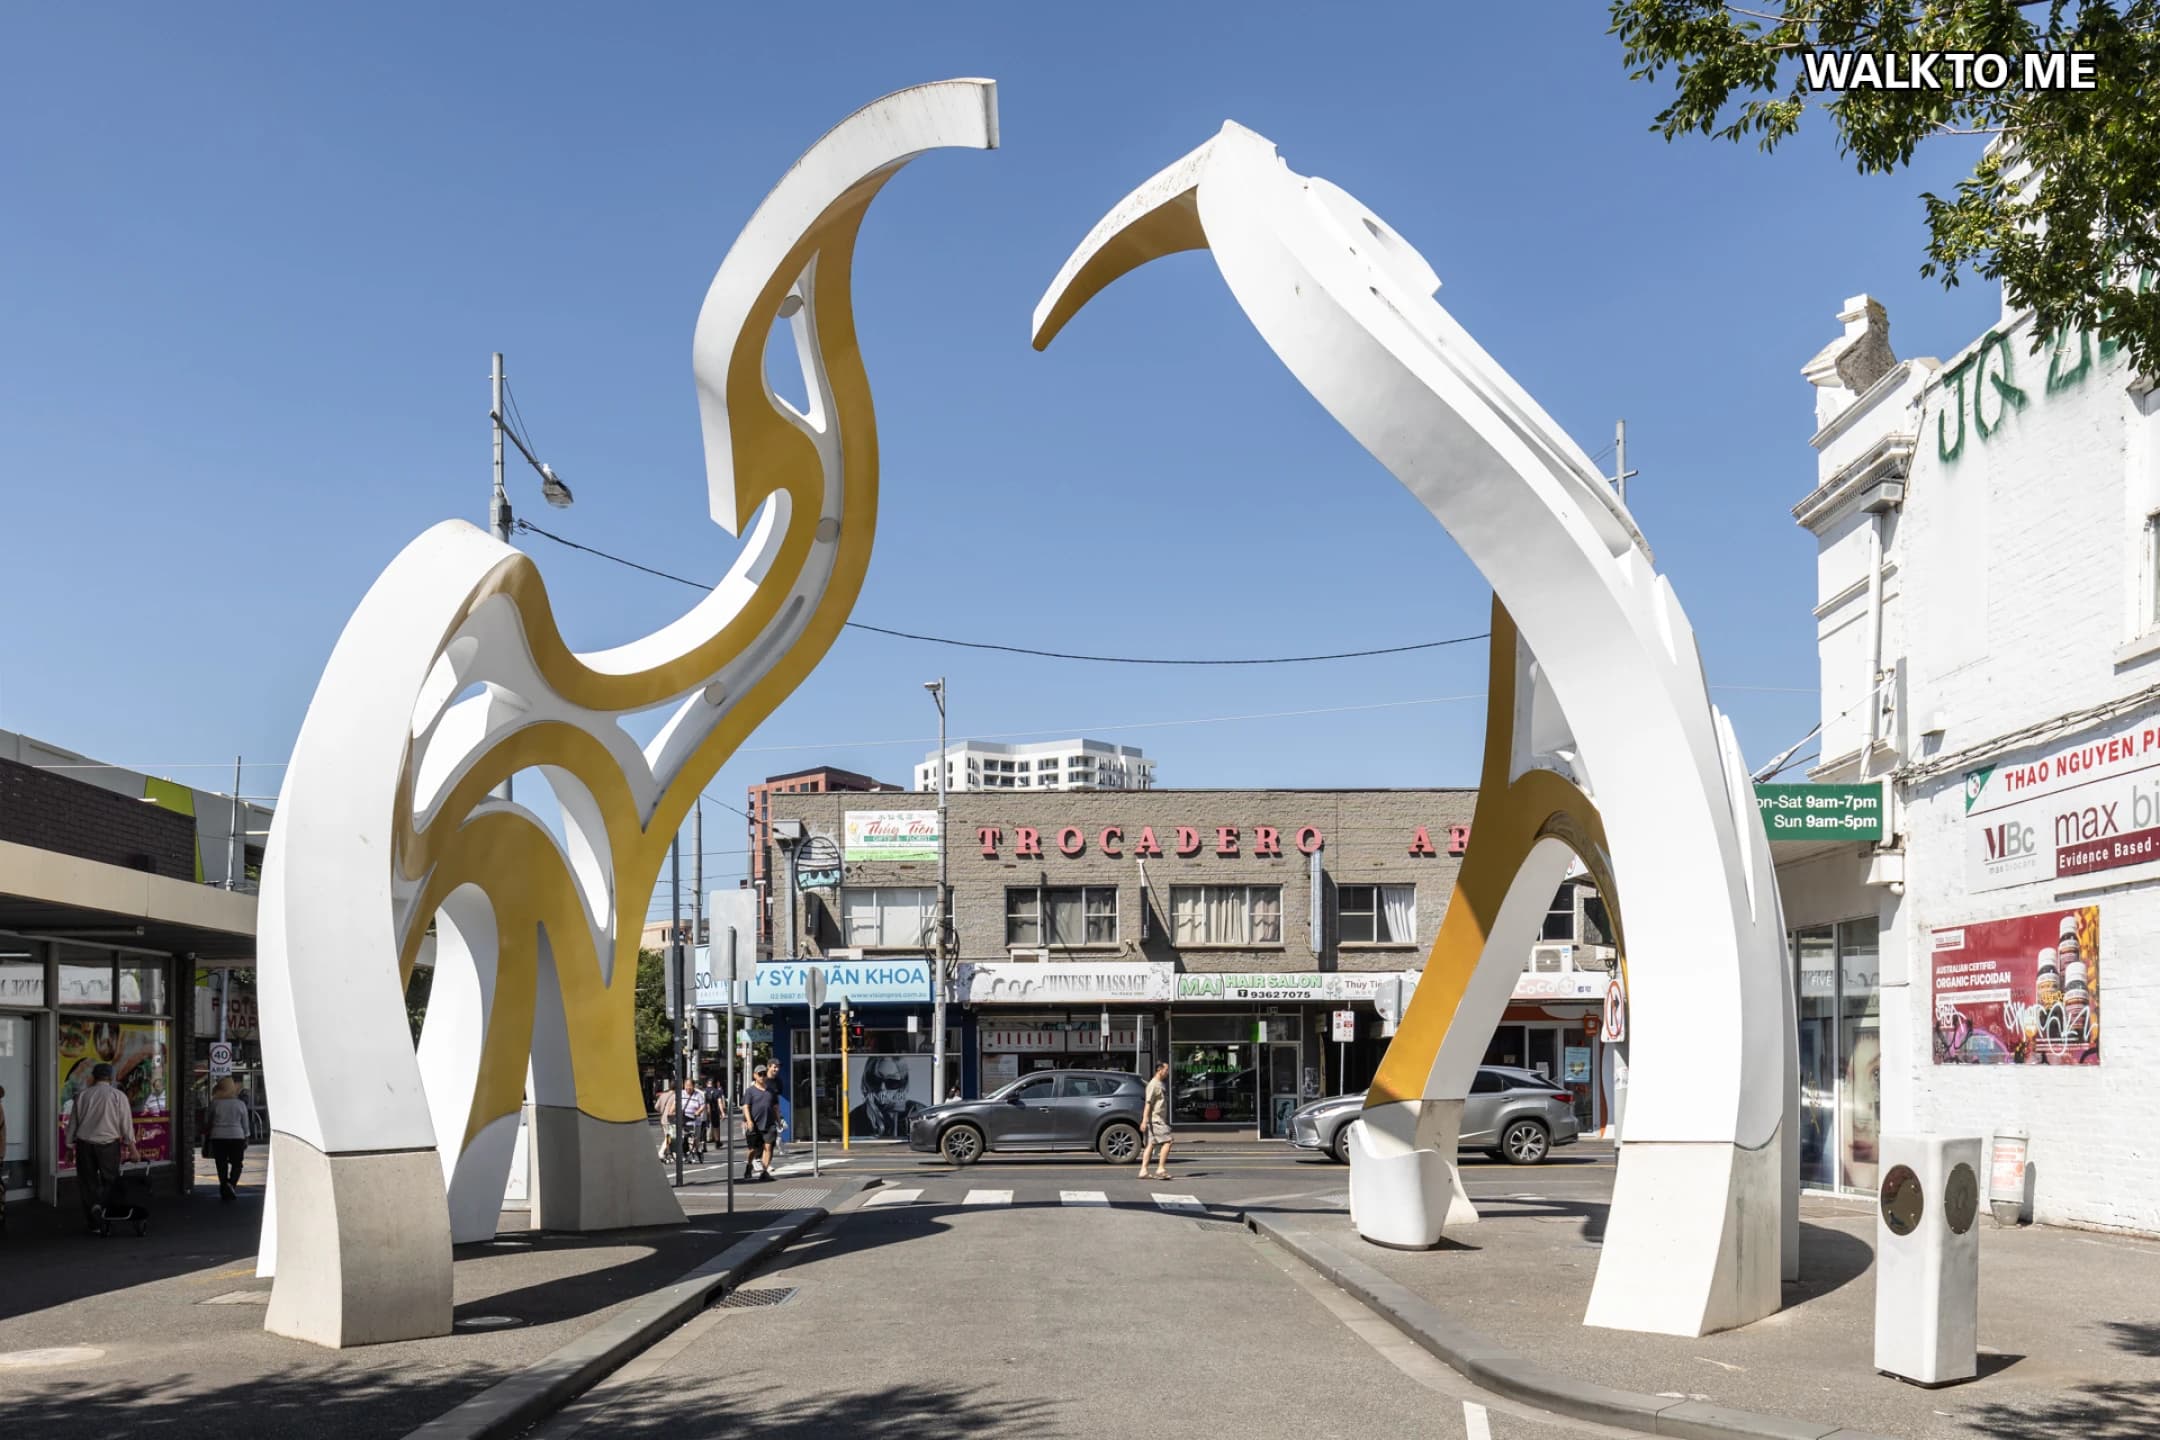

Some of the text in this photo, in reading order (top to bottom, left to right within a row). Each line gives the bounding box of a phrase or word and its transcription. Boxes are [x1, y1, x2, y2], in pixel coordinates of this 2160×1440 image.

[2004, 761, 2050, 792] THAO
[2056, 735, 2134, 778] NGUYEN
[1756, 794, 1878, 811] on-Sat 9am-7pm
[1773, 814, 1878, 830] Sun 9am-5pm
[2054, 800, 2120, 847] max
[976, 826, 1323, 857] TROCADERO
[1983, 820, 2035, 862] MBc
[2059, 837, 2152, 869] Evidence Based
[799, 965, 860, 985] NÃN
[865, 967, 925, 985] KHOA
[1042, 974, 1148, 992] CHINESE MASSAGE
[1225, 974, 1322, 989] HAIR SALON
[1936, 971, 2011, 989] ORGANIC FUCOIDAN
[1180, 978, 1223, 997] MAI
[214, 1050, 229, 1060] 40
[211, 1066, 231, 1074] AREA
